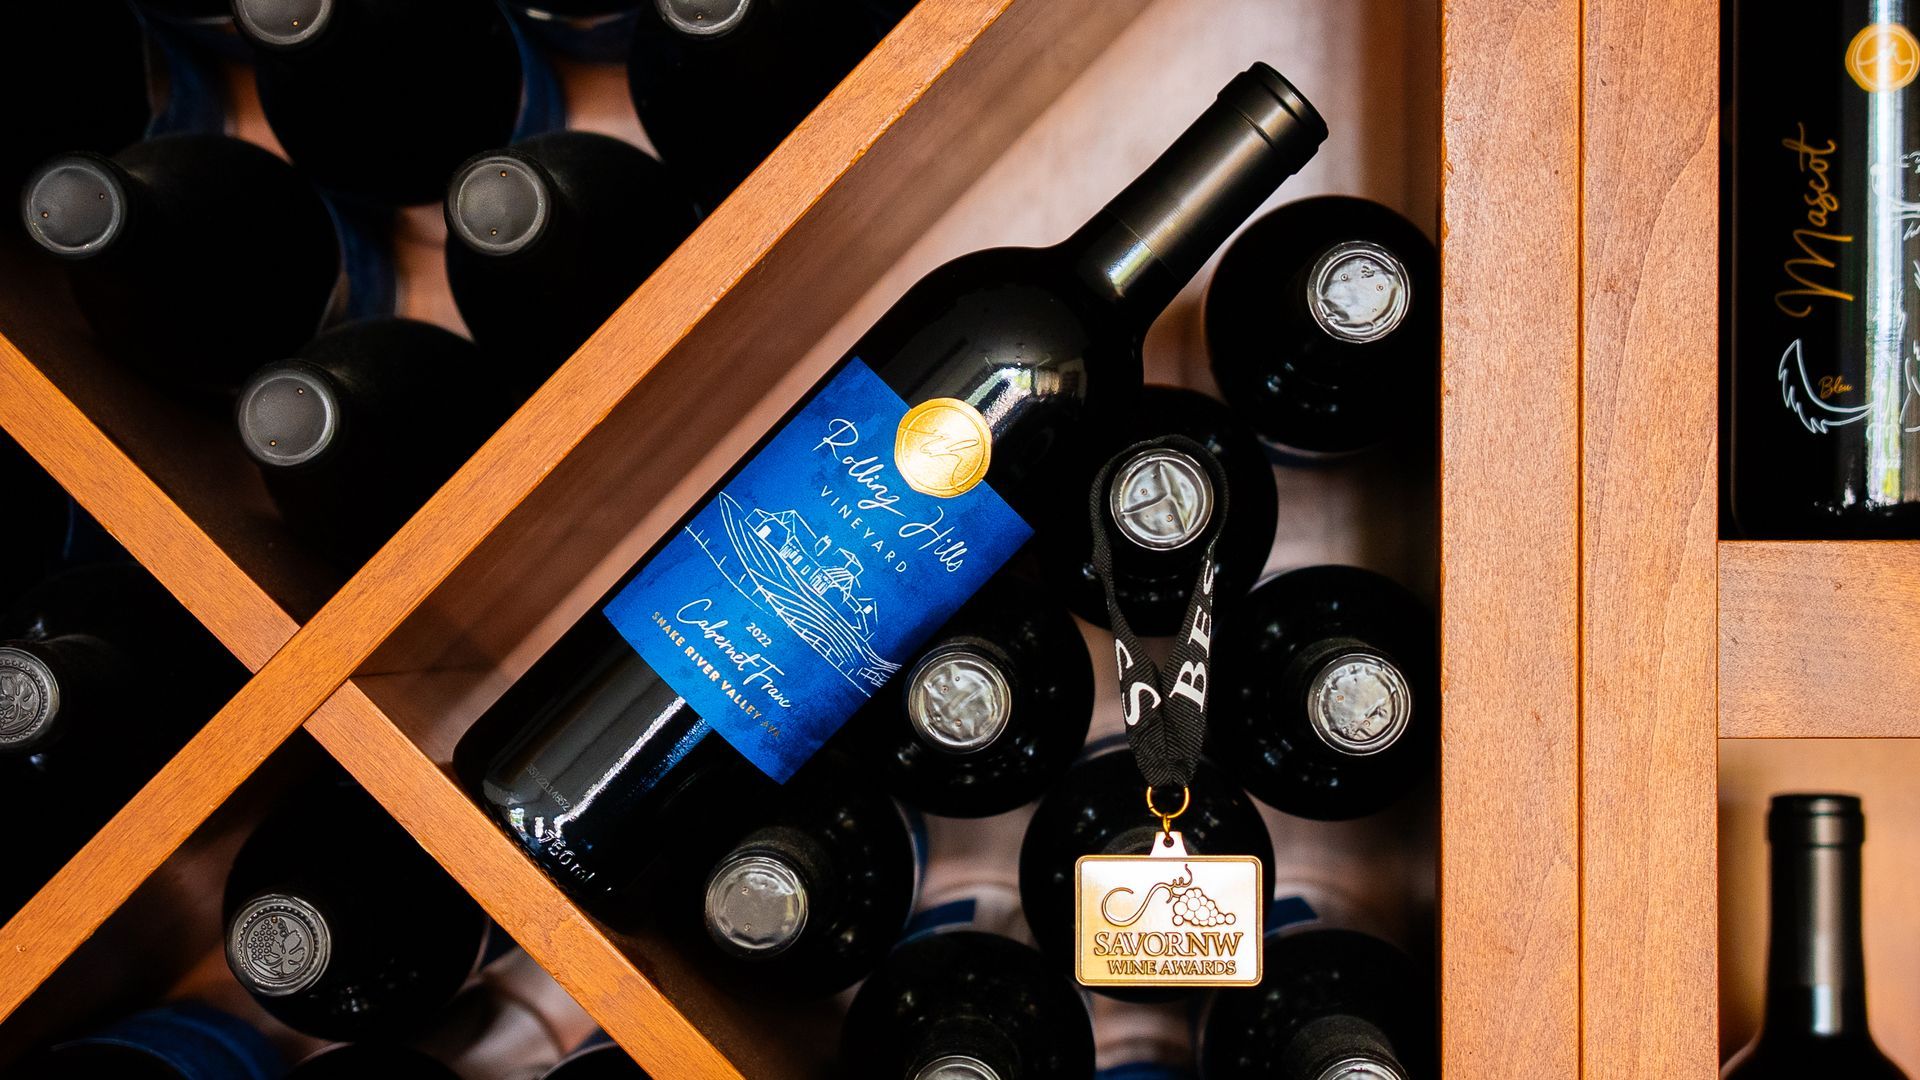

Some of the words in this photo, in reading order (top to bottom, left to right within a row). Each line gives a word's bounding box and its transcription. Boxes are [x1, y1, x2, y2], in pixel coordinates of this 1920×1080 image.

[1775, 122, 1854, 317] Mascot
[811, 418, 906, 518] Rolling
[898, 505, 968, 573] Hills
[821, 485, 907, 573] VINEYARD
[651, 611, 686, 647] SNAKE
[684, 645, 721, 682] RIVER
[721, 679, 762, 719] VALLEY
[676, 598, 761, 671] Cabernet
[743, 656, 791, 708] Franc
[745, 622, 773, 648] 2022
[1094, 931, 1244, 957] SAVORNW
[1107, 959, 1158, 975] WINE
[1159, 959, 1237, 976] AWARDS
